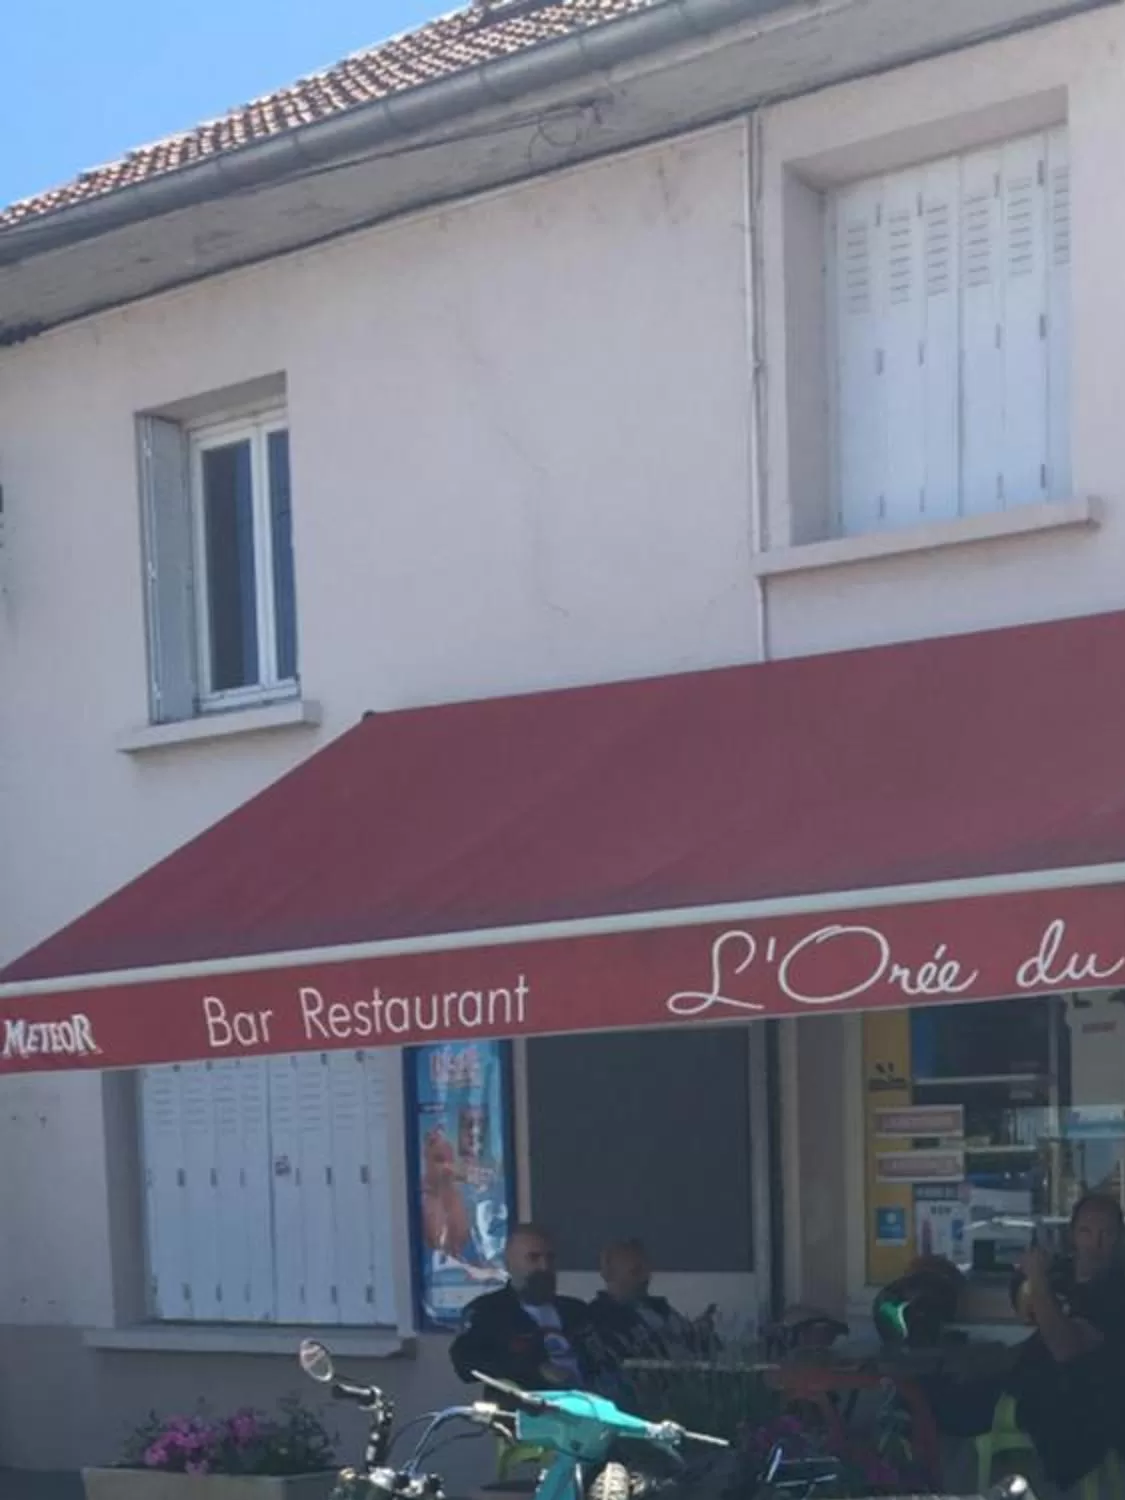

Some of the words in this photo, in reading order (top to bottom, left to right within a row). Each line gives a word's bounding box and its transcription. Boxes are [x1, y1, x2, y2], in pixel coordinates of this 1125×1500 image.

[666, 922, 978, 1015] L'Orée
[203, 995, 273, 1047] Bar
[298, 974, 529, 1040] Restaurant
